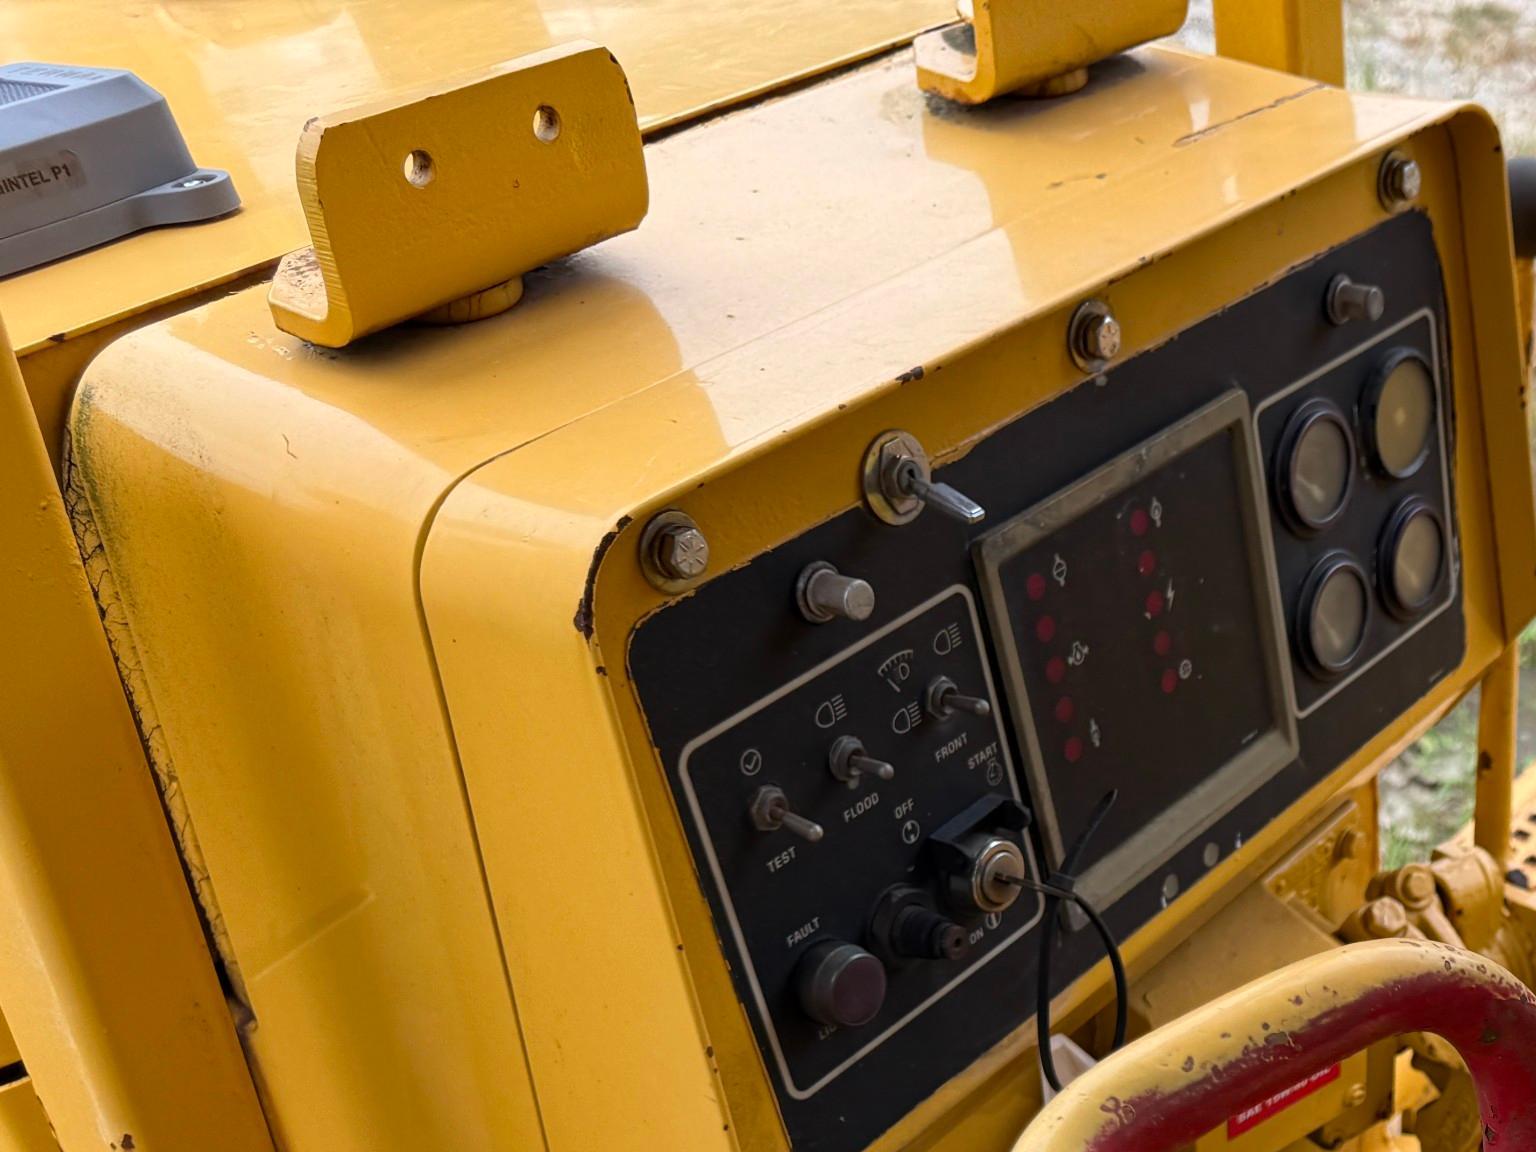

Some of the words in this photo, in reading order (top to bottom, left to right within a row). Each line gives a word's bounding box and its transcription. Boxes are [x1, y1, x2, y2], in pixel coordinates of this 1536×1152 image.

[0, 169, 51, 194] INTEL
[51, 163, 71, 180] P1
[935, 732, 968, 763] FRONT
[967, 742, 998, 770] START
[843, 792, 880, 823] FLOOD
[894, 798, 916, 819] OFF
[766, 846, 798, 873] TEST
[786, 916, 822, 948] FAULT
[969, 927, 984, 945] ON
